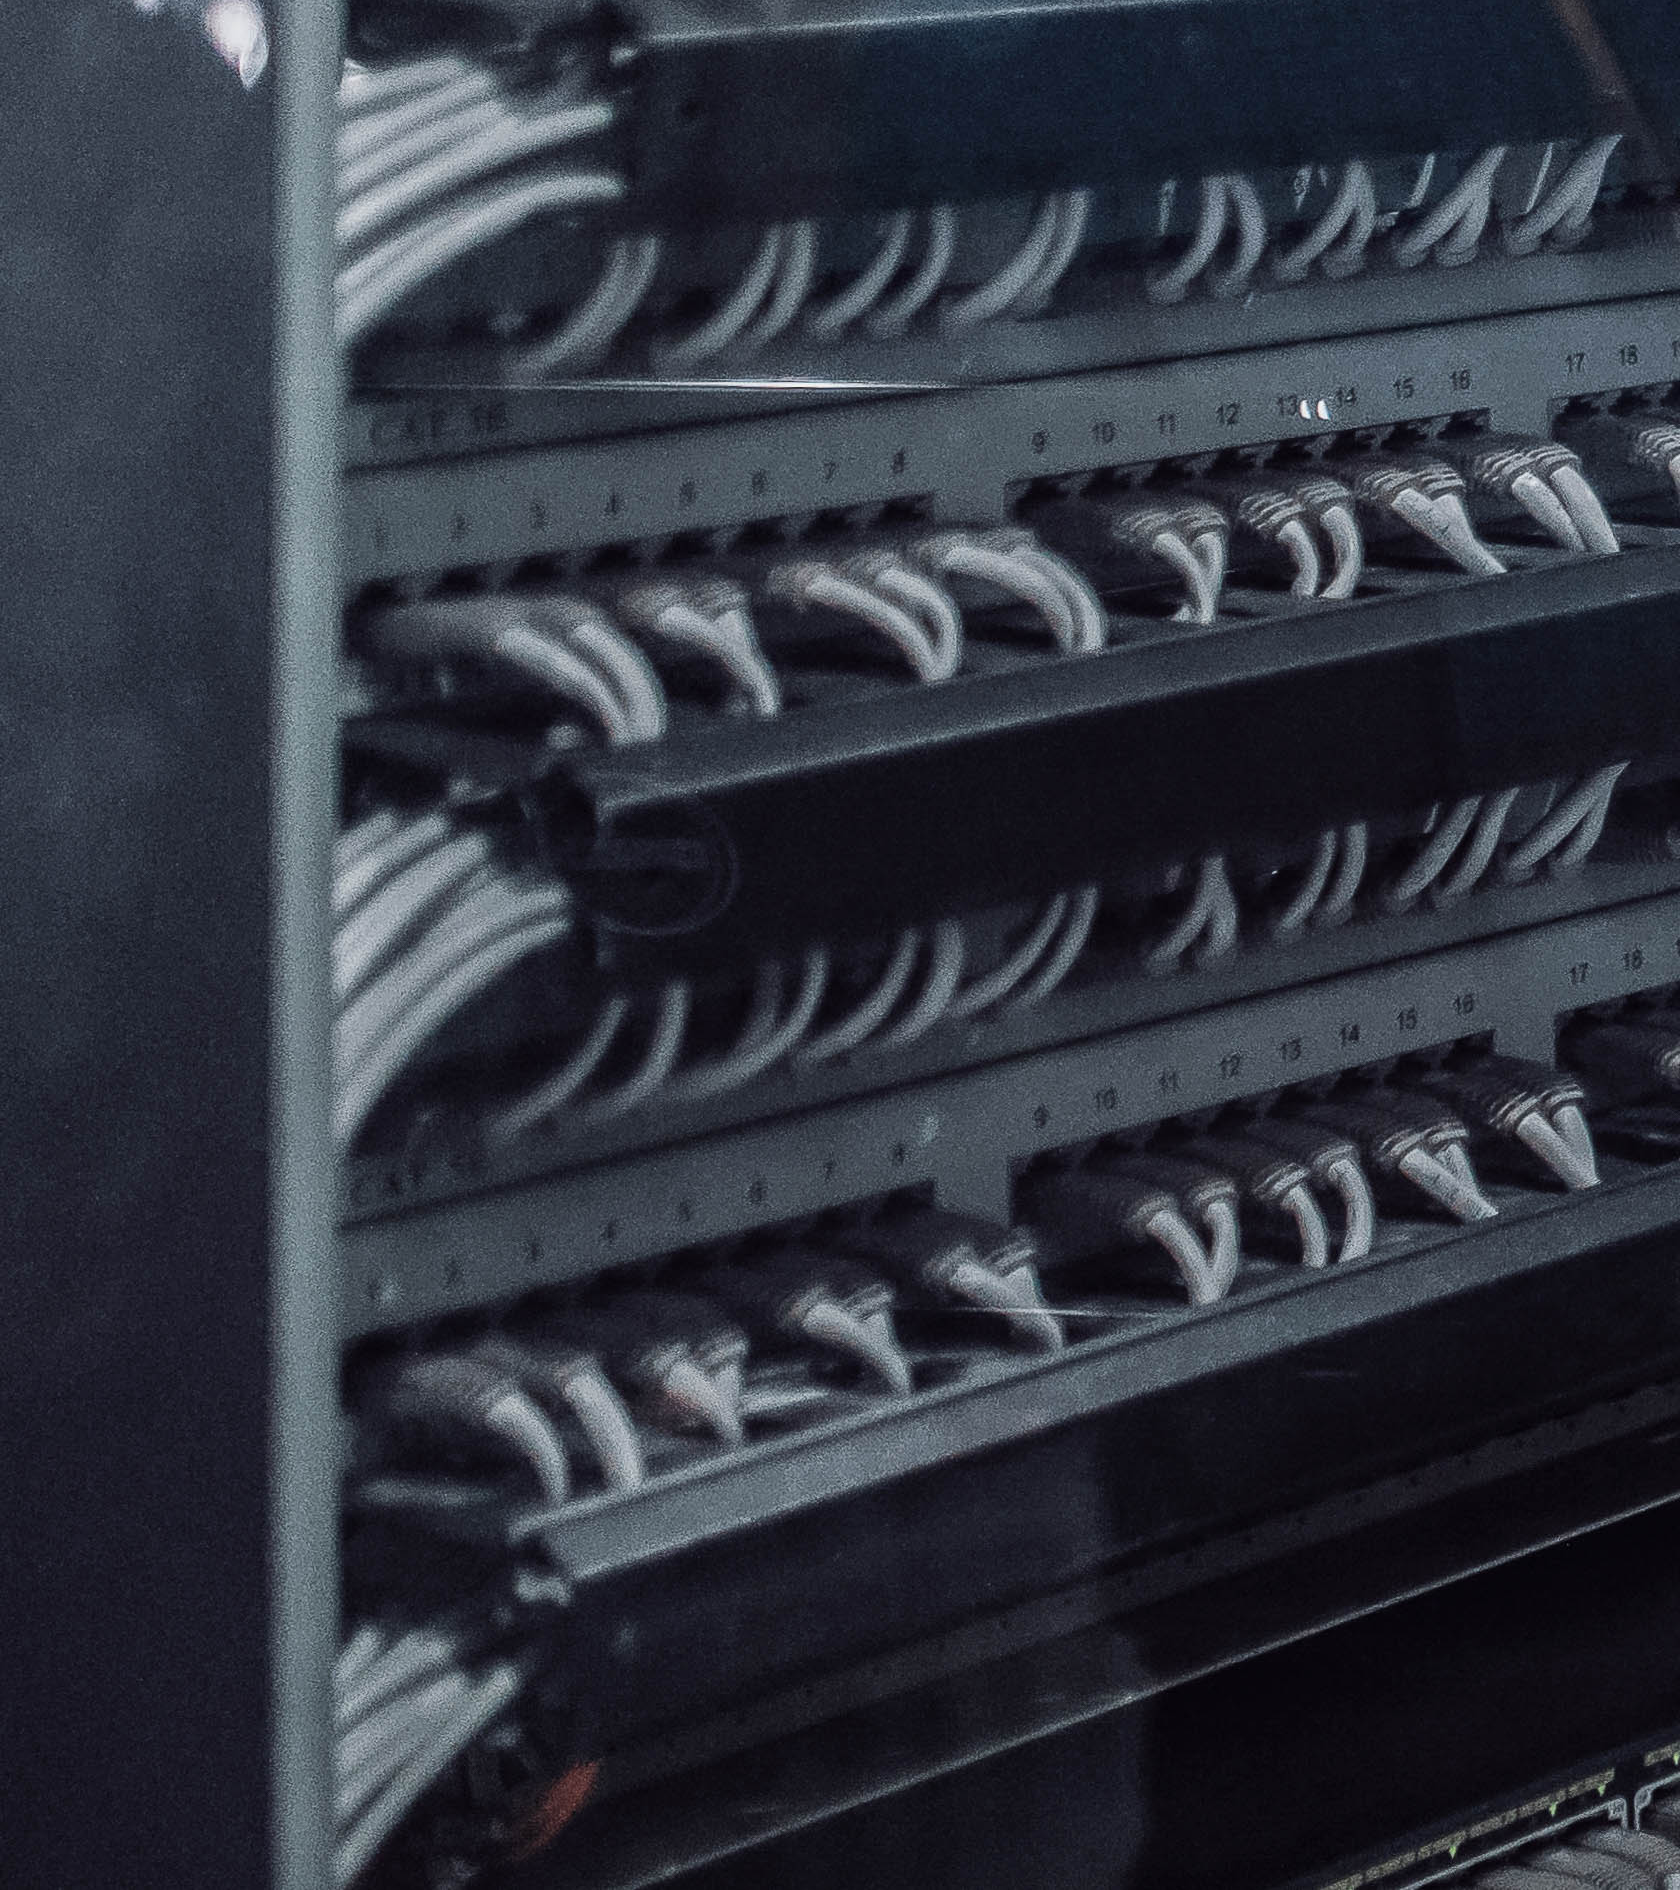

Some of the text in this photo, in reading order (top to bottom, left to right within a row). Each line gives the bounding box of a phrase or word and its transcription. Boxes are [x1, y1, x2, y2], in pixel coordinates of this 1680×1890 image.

[824, 460, 838, 481] 7
[1032, 431, 1047, 454] 9
[1092, 421, 1116, 444] 10
[1157, 413, 1176, 433] 11
[1217, 402, 1241, 426] 12
[1276, 393, 1299, 416] 13
[1335, 387, 1358, 408] 14
[1393, 377, 1415, 398] 15
[1450, 369, 1471, 390] 16
[1564, 352, 1583, 373] 17
[1615, 345, 1635, 366] 18
[1033, 1105, 1049, 1128] 9
[1094, 1087, 1117, 1109] 10
[1158, 1071, 1178, 1092] 11
[1219, 1054, 1243, 1077] 12
[1280, 1037, 1302, 1061] 13
[1338, 1023, 1358, 1046] 14
[1397, 1007, 1418, 1030] 15
[1454, 993, 1475, 1014] 16
[1571, 962, 1590, 986] 17
[1623, 949, 1643, 969] 18
